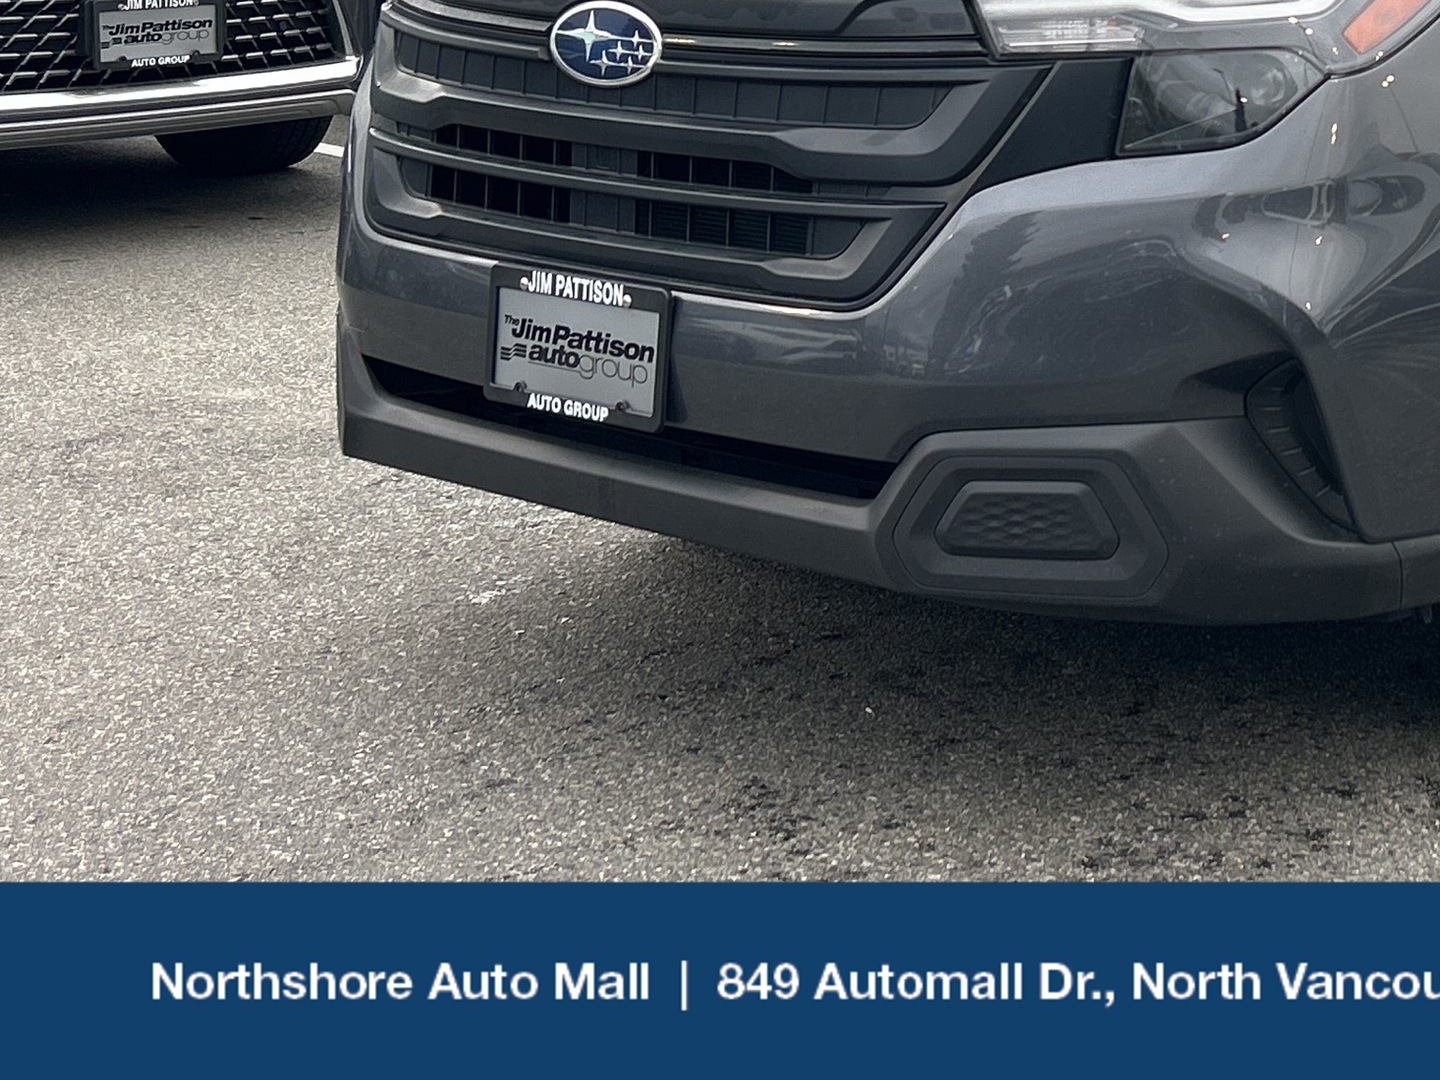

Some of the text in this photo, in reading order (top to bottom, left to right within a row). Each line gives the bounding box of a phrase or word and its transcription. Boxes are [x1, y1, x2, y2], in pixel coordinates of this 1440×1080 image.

[131, 54, 190, 68] AUTO GROUP
[528, 270, 624, 307] JIM PATTISON
[527, 392, 609, 422] AUTO GROUP
